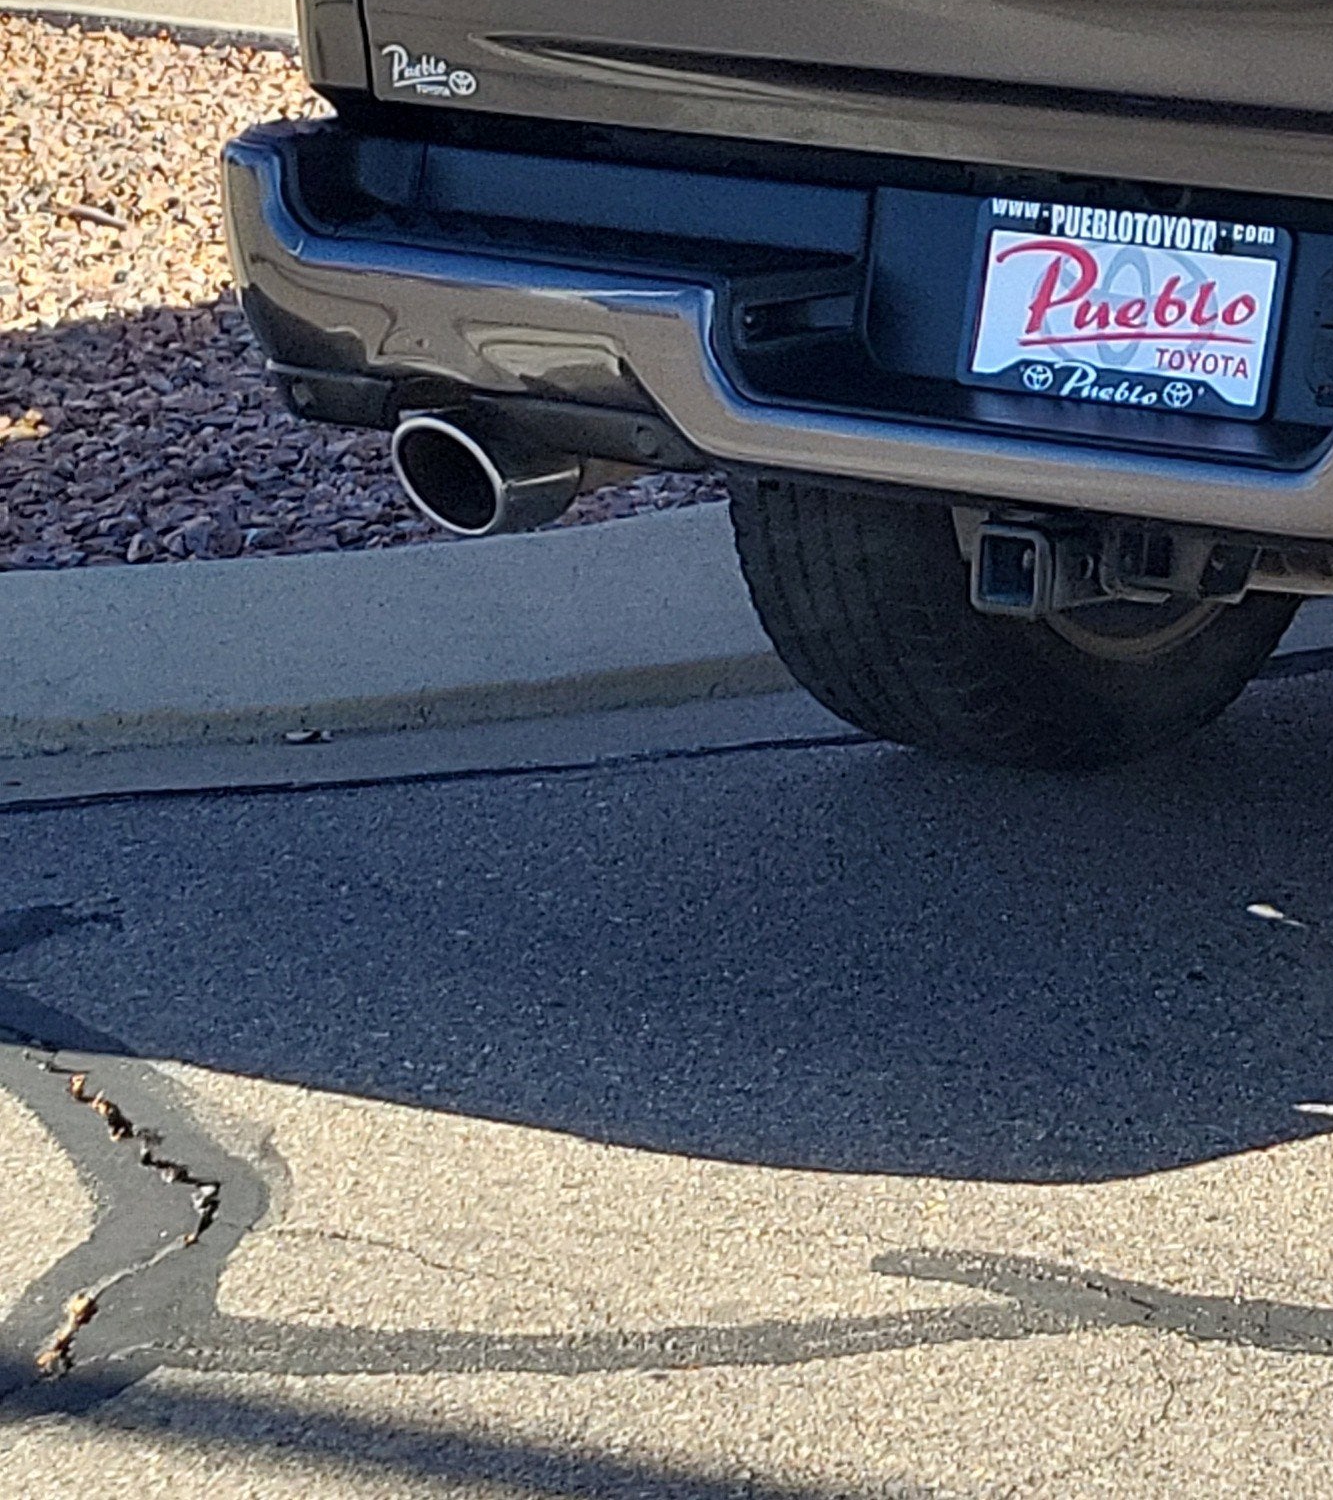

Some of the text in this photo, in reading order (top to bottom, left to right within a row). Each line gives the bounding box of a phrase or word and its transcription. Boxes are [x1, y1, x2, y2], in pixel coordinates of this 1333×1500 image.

[381, 44, 447, 82] Pueblo
[995, 239, 1257, 335] Pueblo
[1053, 360, 1158, 405] Pueblo
[1156, 347, 1249, 379] TOYOTA
